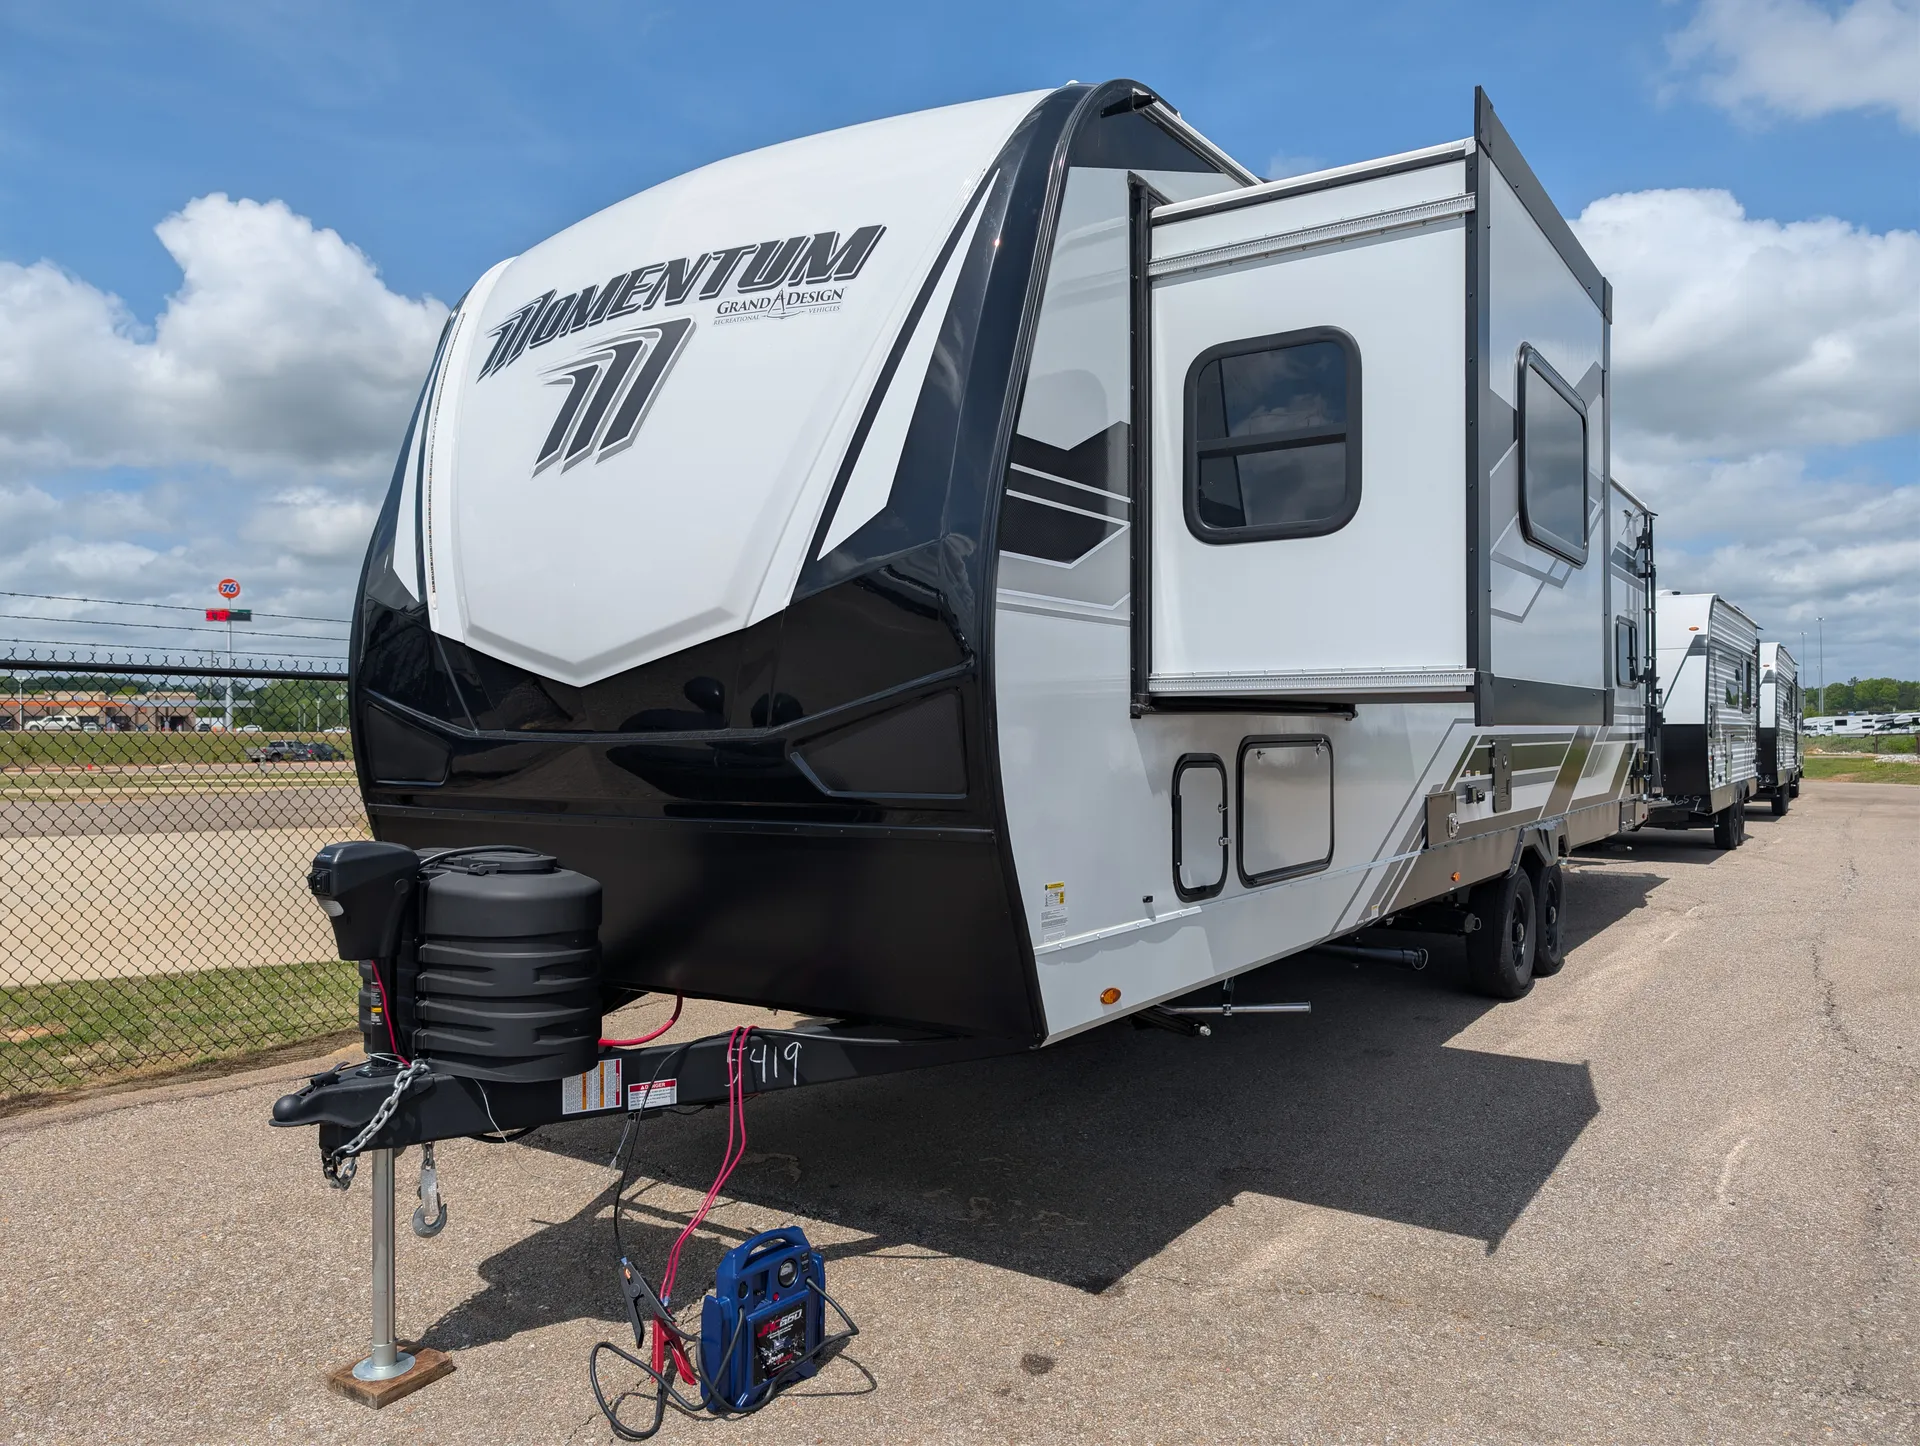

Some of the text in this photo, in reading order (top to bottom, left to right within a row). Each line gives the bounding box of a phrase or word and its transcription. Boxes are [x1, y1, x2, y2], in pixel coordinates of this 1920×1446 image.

[477, 224, 888, 384] MOMENTUM
[716, 287, 845, 315] GRAND DESIGN
[713, 305, 841, 326] RECREATIONAL VEHICLES
[222, 583, 237, 593] 76
[1668, 794, 1702, 812] 659
[644, 1082, 666, 1090] DNGER
